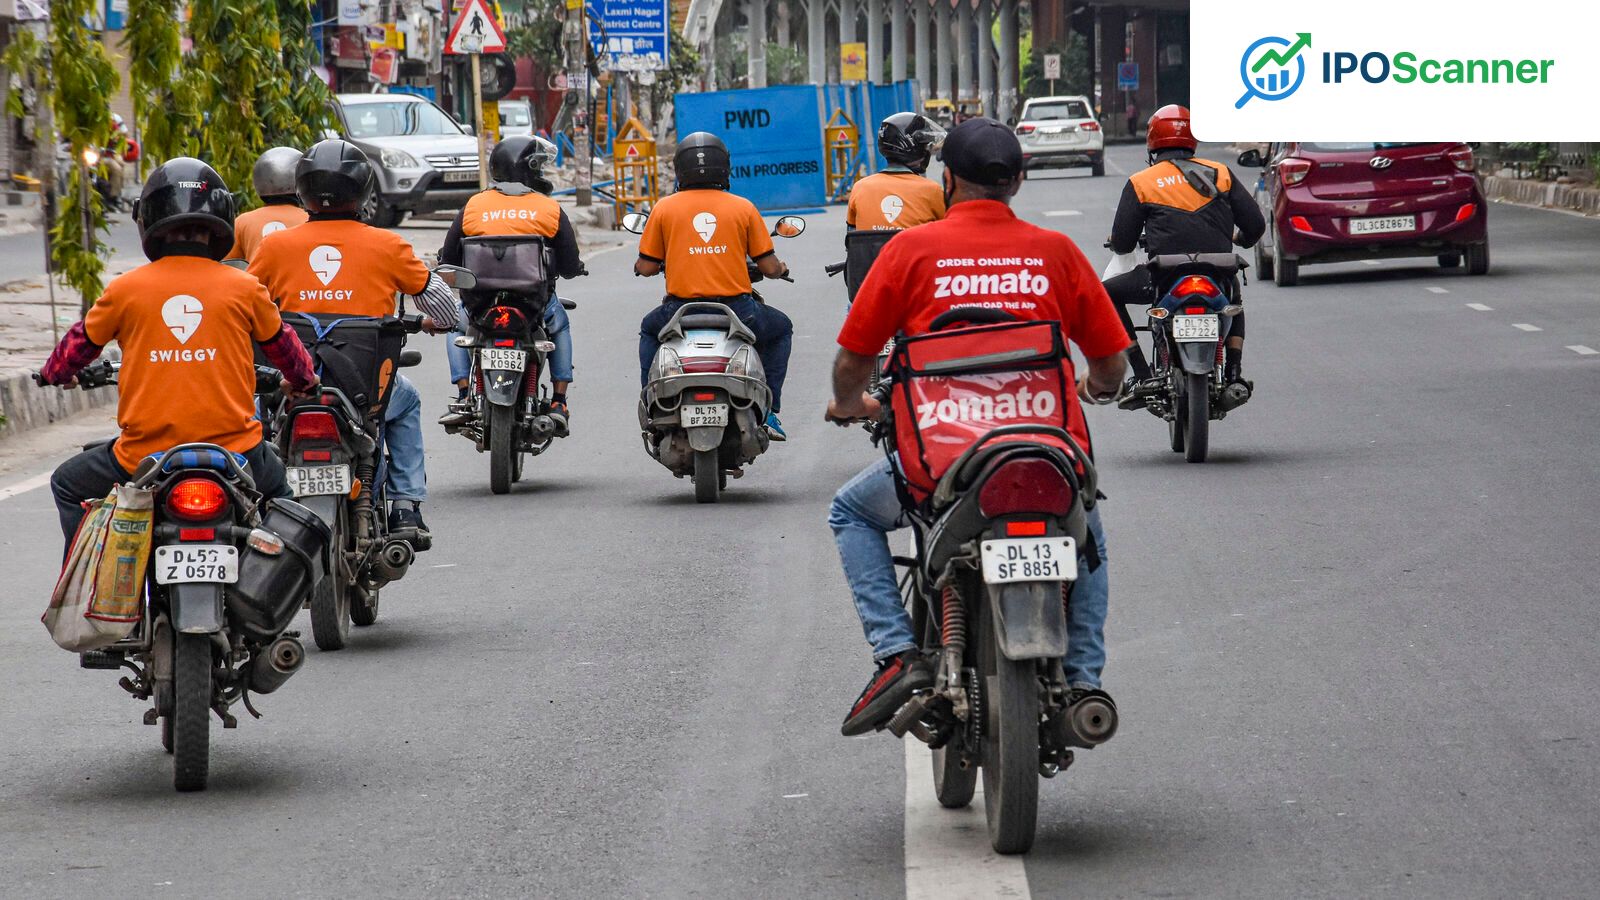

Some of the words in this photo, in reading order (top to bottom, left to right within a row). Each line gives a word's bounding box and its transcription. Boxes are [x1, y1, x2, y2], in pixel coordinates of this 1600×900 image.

[605, 7, 632, 16] Laxmi
[634, 8, 661, 17] Nagar
[602, 20, 630, 28] istrict
[632, 20, 661, 28] Centre
[725, 109, 770, 129] PWD
[754, 161, 819, 177] PROGRESS
[482, 209, 537, 222] SWIGGY
[689, 245, 728, 255] SWIGGY
[936, 259, 975, 267] ORDER
[977, 258, 1022, 266] ONLINE
[1024, 258, 1043, 266] ON
[934, 269, 1049, 298] zomato
[299, 290, 353, 300] SWIGGY
[1021, 302, 1036, 310] APP
[150, 349, 217, 362] SWIGGY
[917, 386, 1056, 430] zomato
[298, 467, 343, 481] DL3SE
[299, 480, 344, 495] F8035
[1007, 545, 1028, 560] DL
[1033, 543, 1052, 559] 13
[998, 563, 1017, 579] SF
[1023, 560, 1060, 577] 8851
